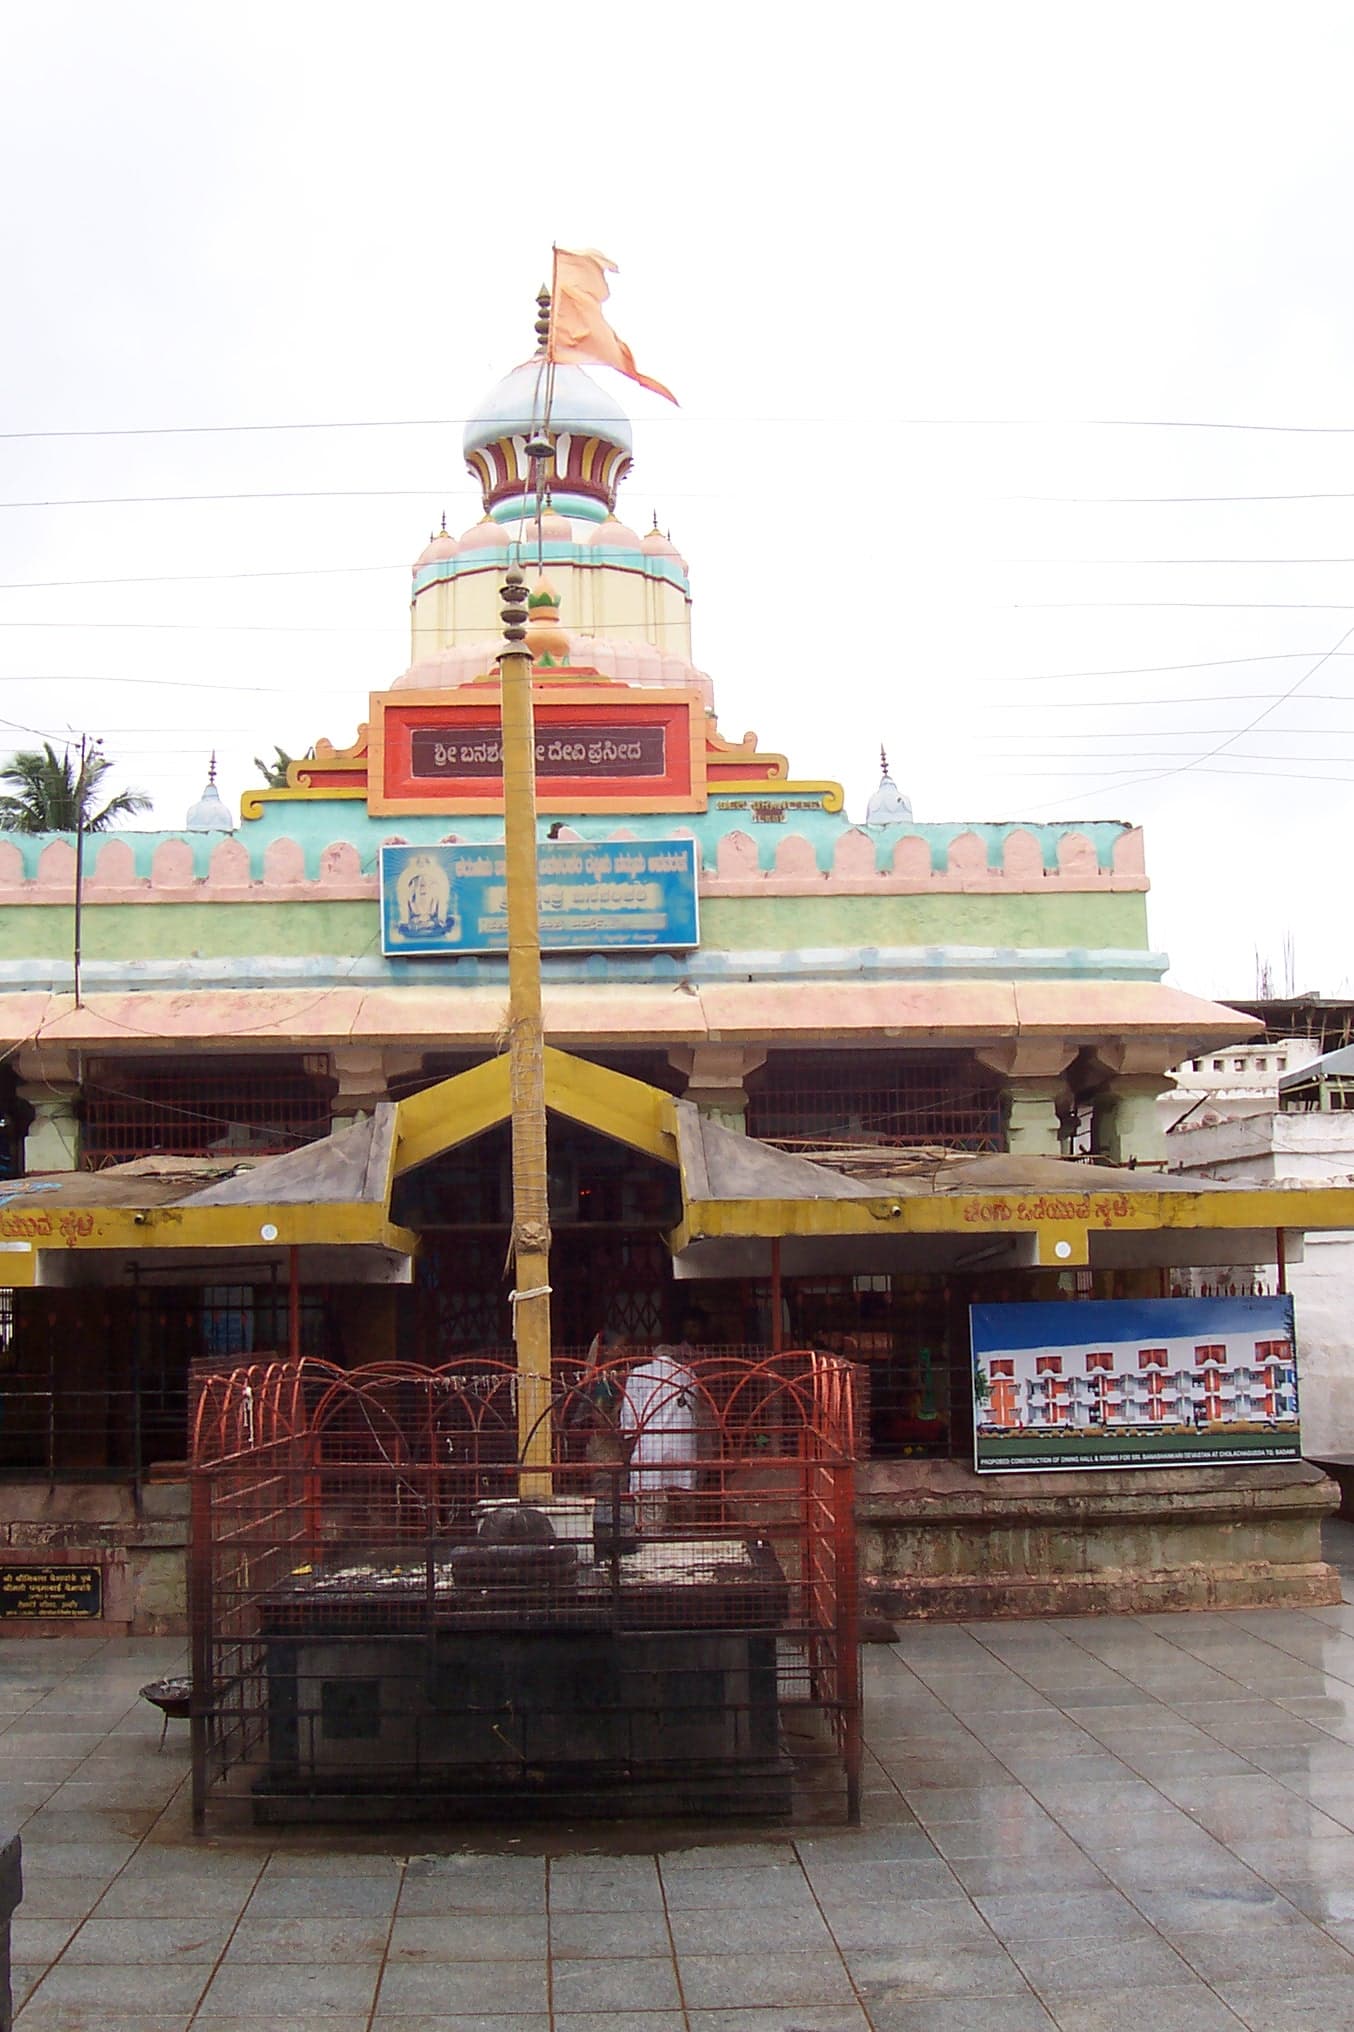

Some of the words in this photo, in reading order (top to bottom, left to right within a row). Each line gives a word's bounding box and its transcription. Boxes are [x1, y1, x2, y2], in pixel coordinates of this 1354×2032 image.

[434, 743, 457, 766] ಶ್ರೀ
[548, 741, 586, 761] ದೇವಿ
[588, 740, 642, 764] ಪ್ರಸೀದ
